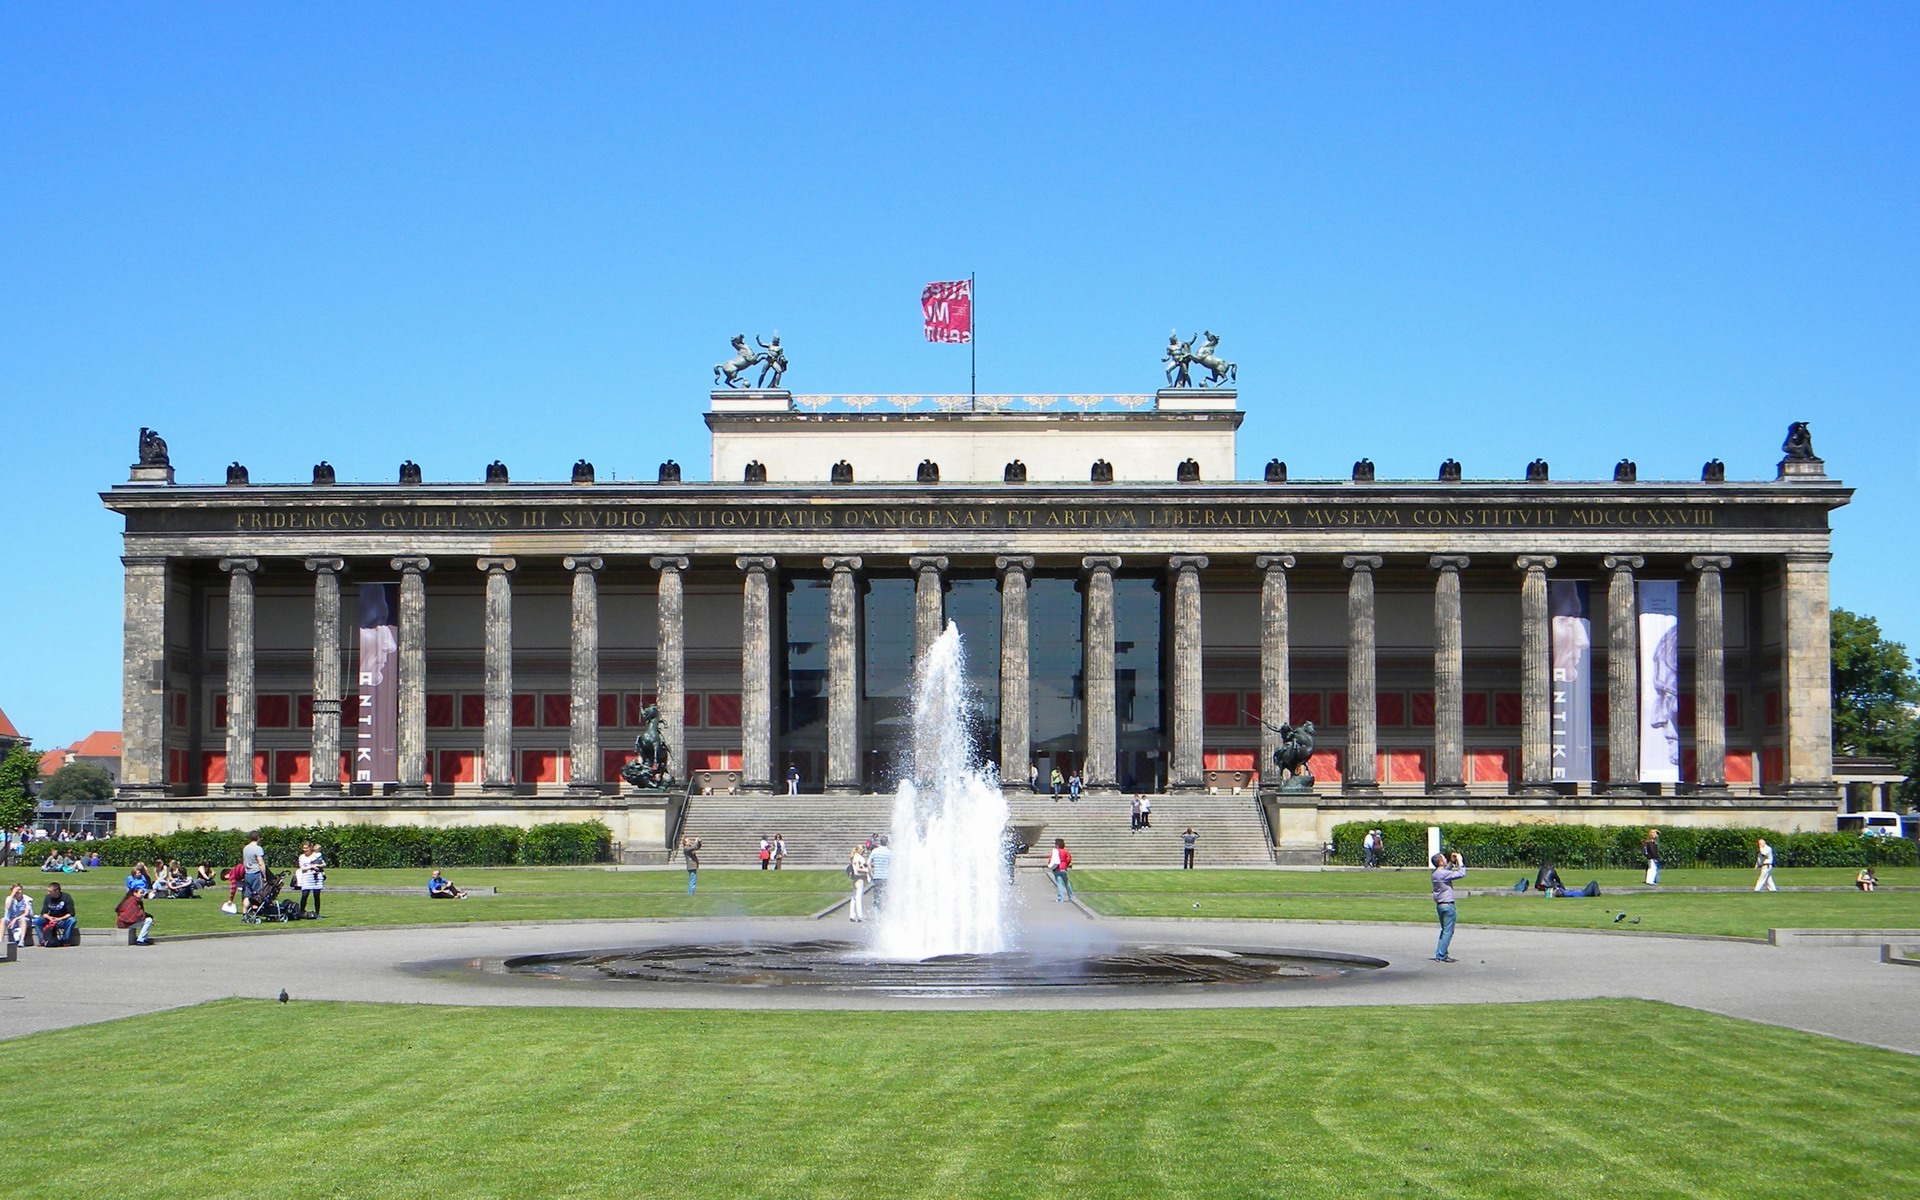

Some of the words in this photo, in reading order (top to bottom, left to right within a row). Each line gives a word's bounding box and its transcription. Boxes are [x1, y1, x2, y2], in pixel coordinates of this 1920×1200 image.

[236, 512, 367, 528] FRIDERICVS
[381, 511, 508, 527] GVILELMVS
[522, 511, 546, 527] III
[561, 511, 646, 527] STVDIO
[661, 511, 833, 526] ANTIQVITATIS
[845, 510, 994, 525] OMNIGENAE
[1007, 510, 1036, 525] ET
[1046, 510, 1137, 525] ARTIVM
[1150, 510, 1291, 525] LIBERALIVM
[1304, 510, 1400, 525] MVSEVM
[1413, 510, 1558, 525] CONSTITVIT
[1569, 510, 1714, 525] MDCCCXXVIII
[357, 672, 373, 781] ANTIKE
[1553, 668, 1567, 779] ANTIKE
